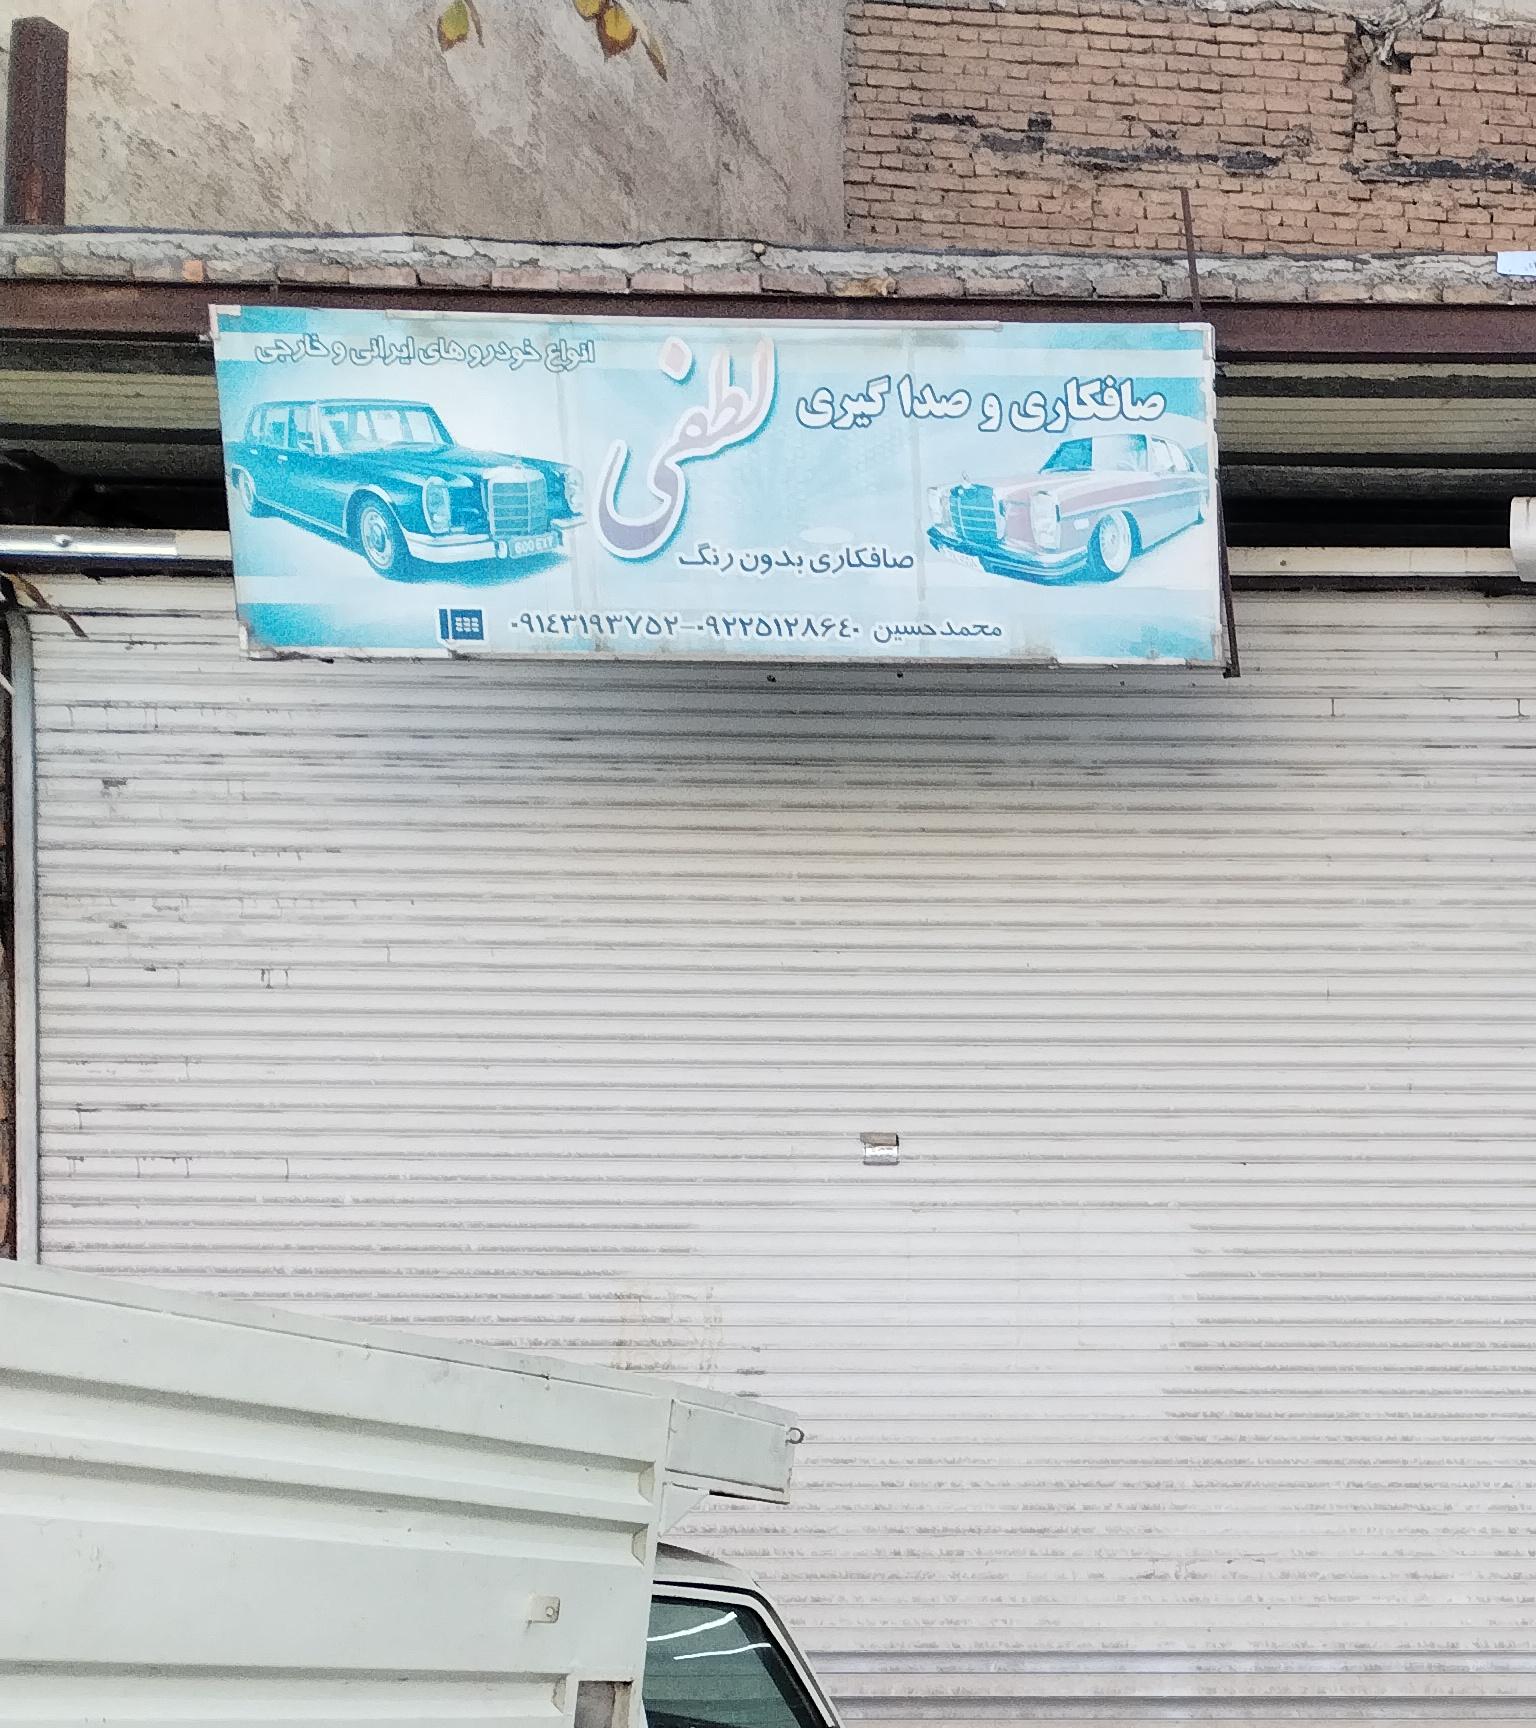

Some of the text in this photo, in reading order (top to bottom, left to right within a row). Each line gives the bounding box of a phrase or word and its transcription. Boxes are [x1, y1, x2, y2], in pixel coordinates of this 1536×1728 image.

[256, 333, 331, 363] خارجی
[350, 335, 415, 366] ایرانی
[543, 340, 597, 373] انواع
[978, 393, 1002, 432] و
[1009, 374, 1168, 434] صافکاری
[597, 336, 776, 560] لطفی
[678, 543, 915, 575] صافکاری بدون رنگ
